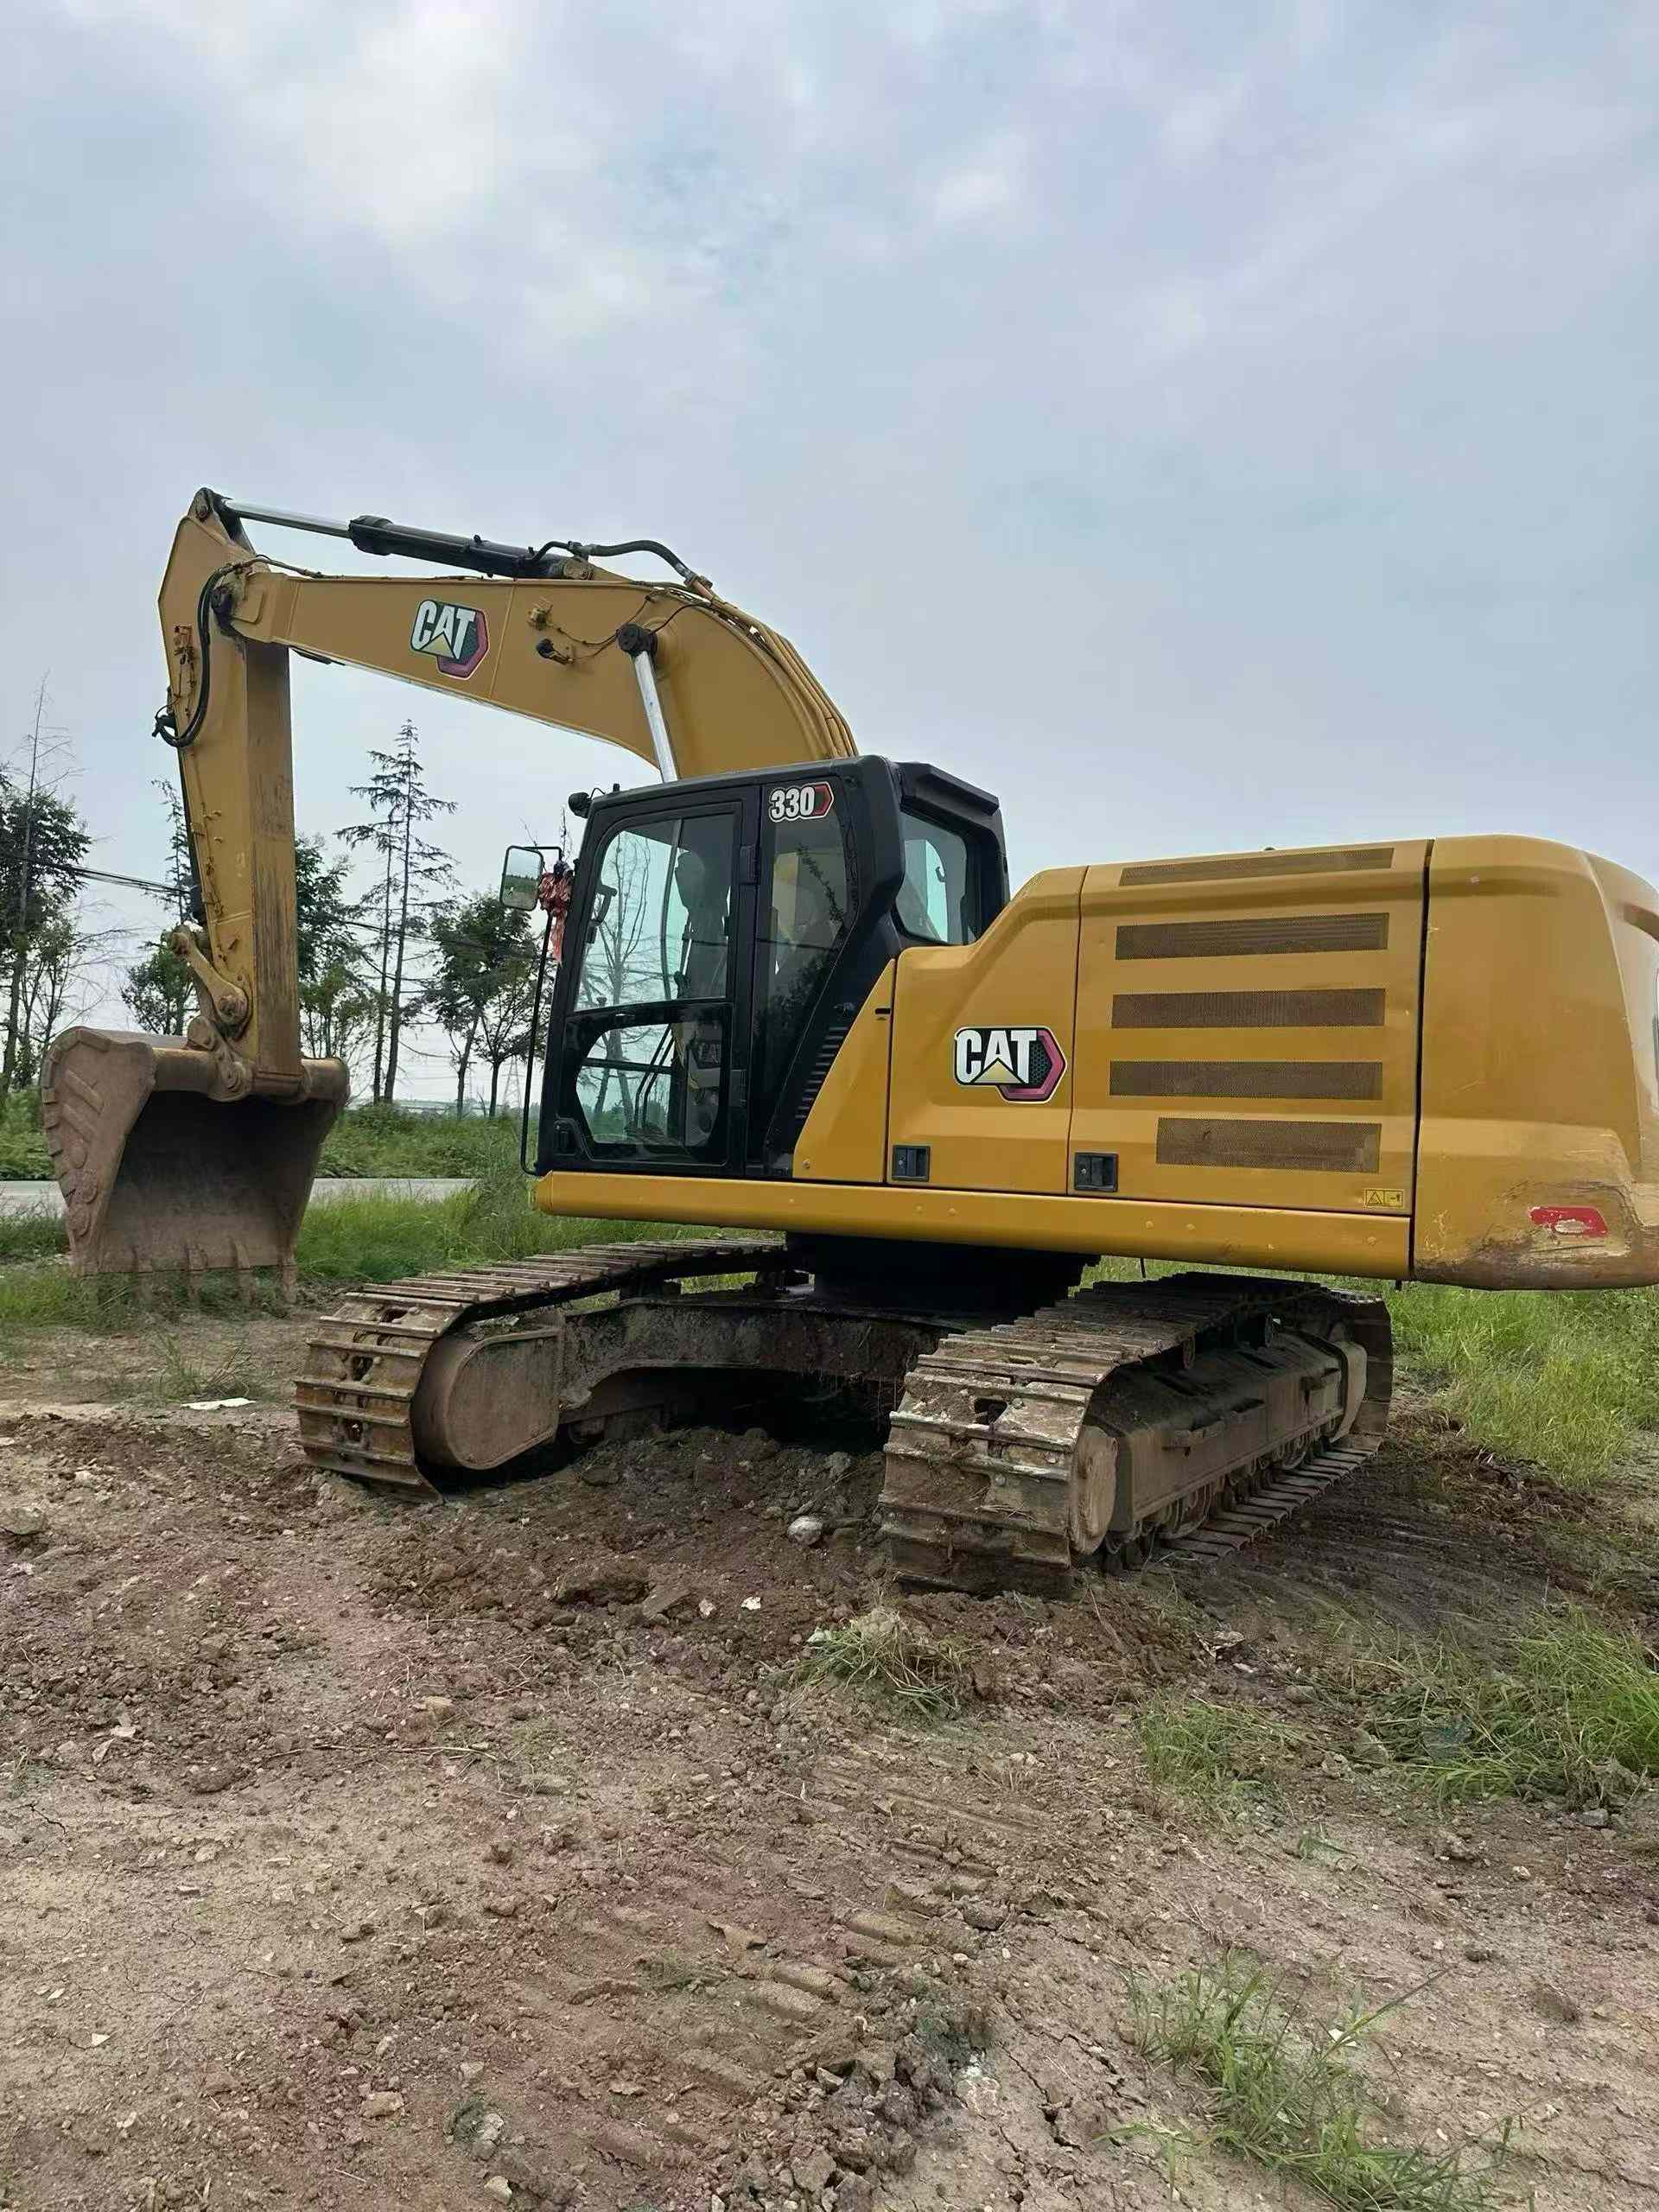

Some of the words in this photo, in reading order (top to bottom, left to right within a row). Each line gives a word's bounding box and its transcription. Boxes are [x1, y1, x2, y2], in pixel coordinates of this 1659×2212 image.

[411, 601, 476, 659] CAT
[771, 786, 815, 819] 330
[956, 1029, 1037, 1084] CAT
